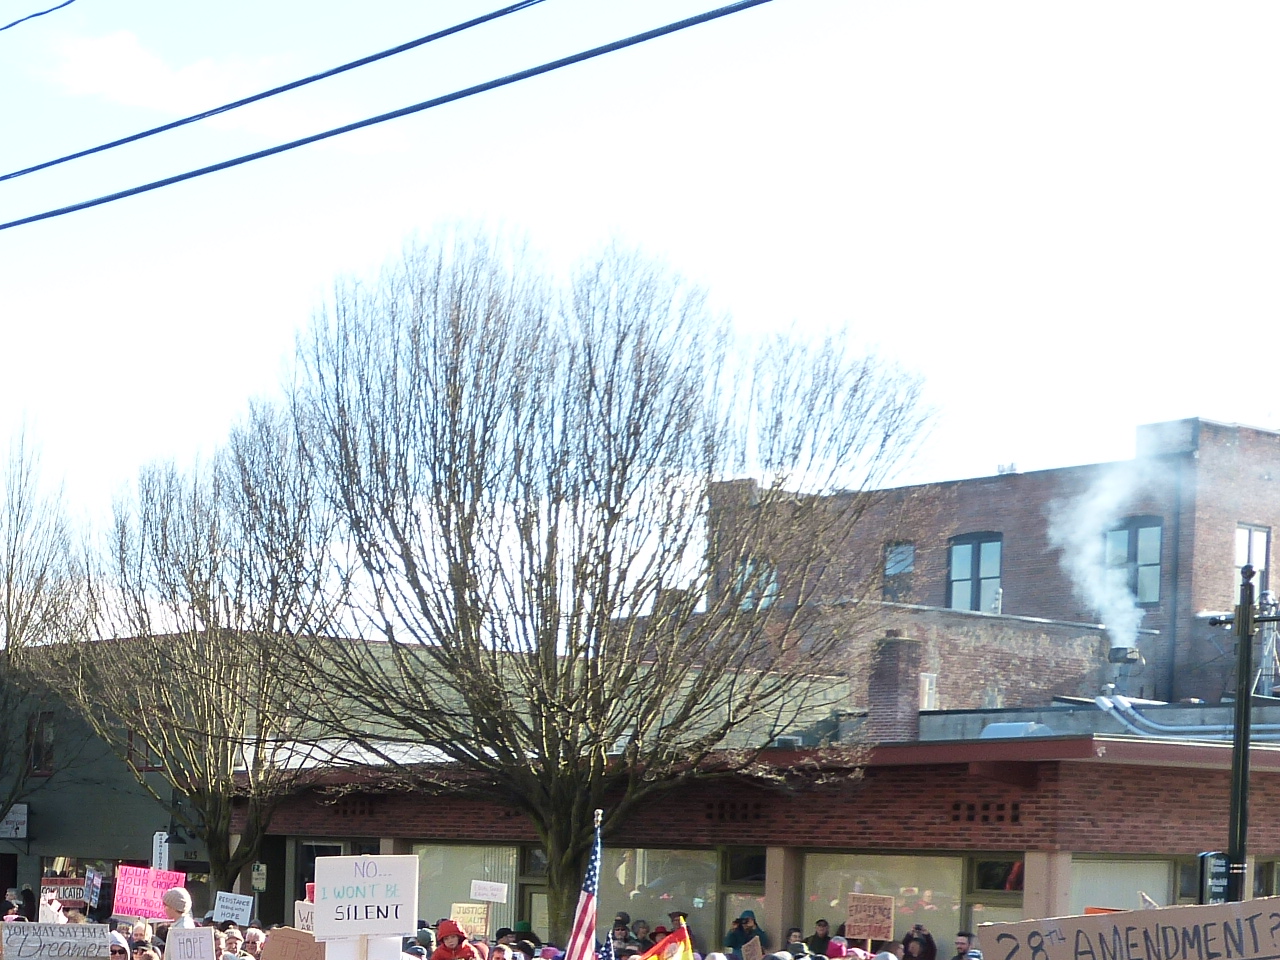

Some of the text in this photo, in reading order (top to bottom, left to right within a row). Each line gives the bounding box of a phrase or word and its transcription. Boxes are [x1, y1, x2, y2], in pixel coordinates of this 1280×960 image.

[120, 867, 180, 885] YOUR BODY
[354, 861, 392, 878] NO...
[119, 877, 149, 888] YOUR
[41, 886, 84, 899] COLICATED
[117, 884, 147, 897] YOUR
[321, 887, 328, 900] I
[385, 883, 400, 899] BE
[220, 911, 240, 920] HOPE
[334, 903, 404, 921] SILENT
[456, 906, 487, 915] JUSTICE
[5, 925, 30, 937] YOU
[32, 925, 57, 937] MAY
[59, 927, 80, 938] SAY
[98, 927, 107, 939] A
[5, 934, 109, 958] Dreamer
[178, 936, 205, 959] HOPE
